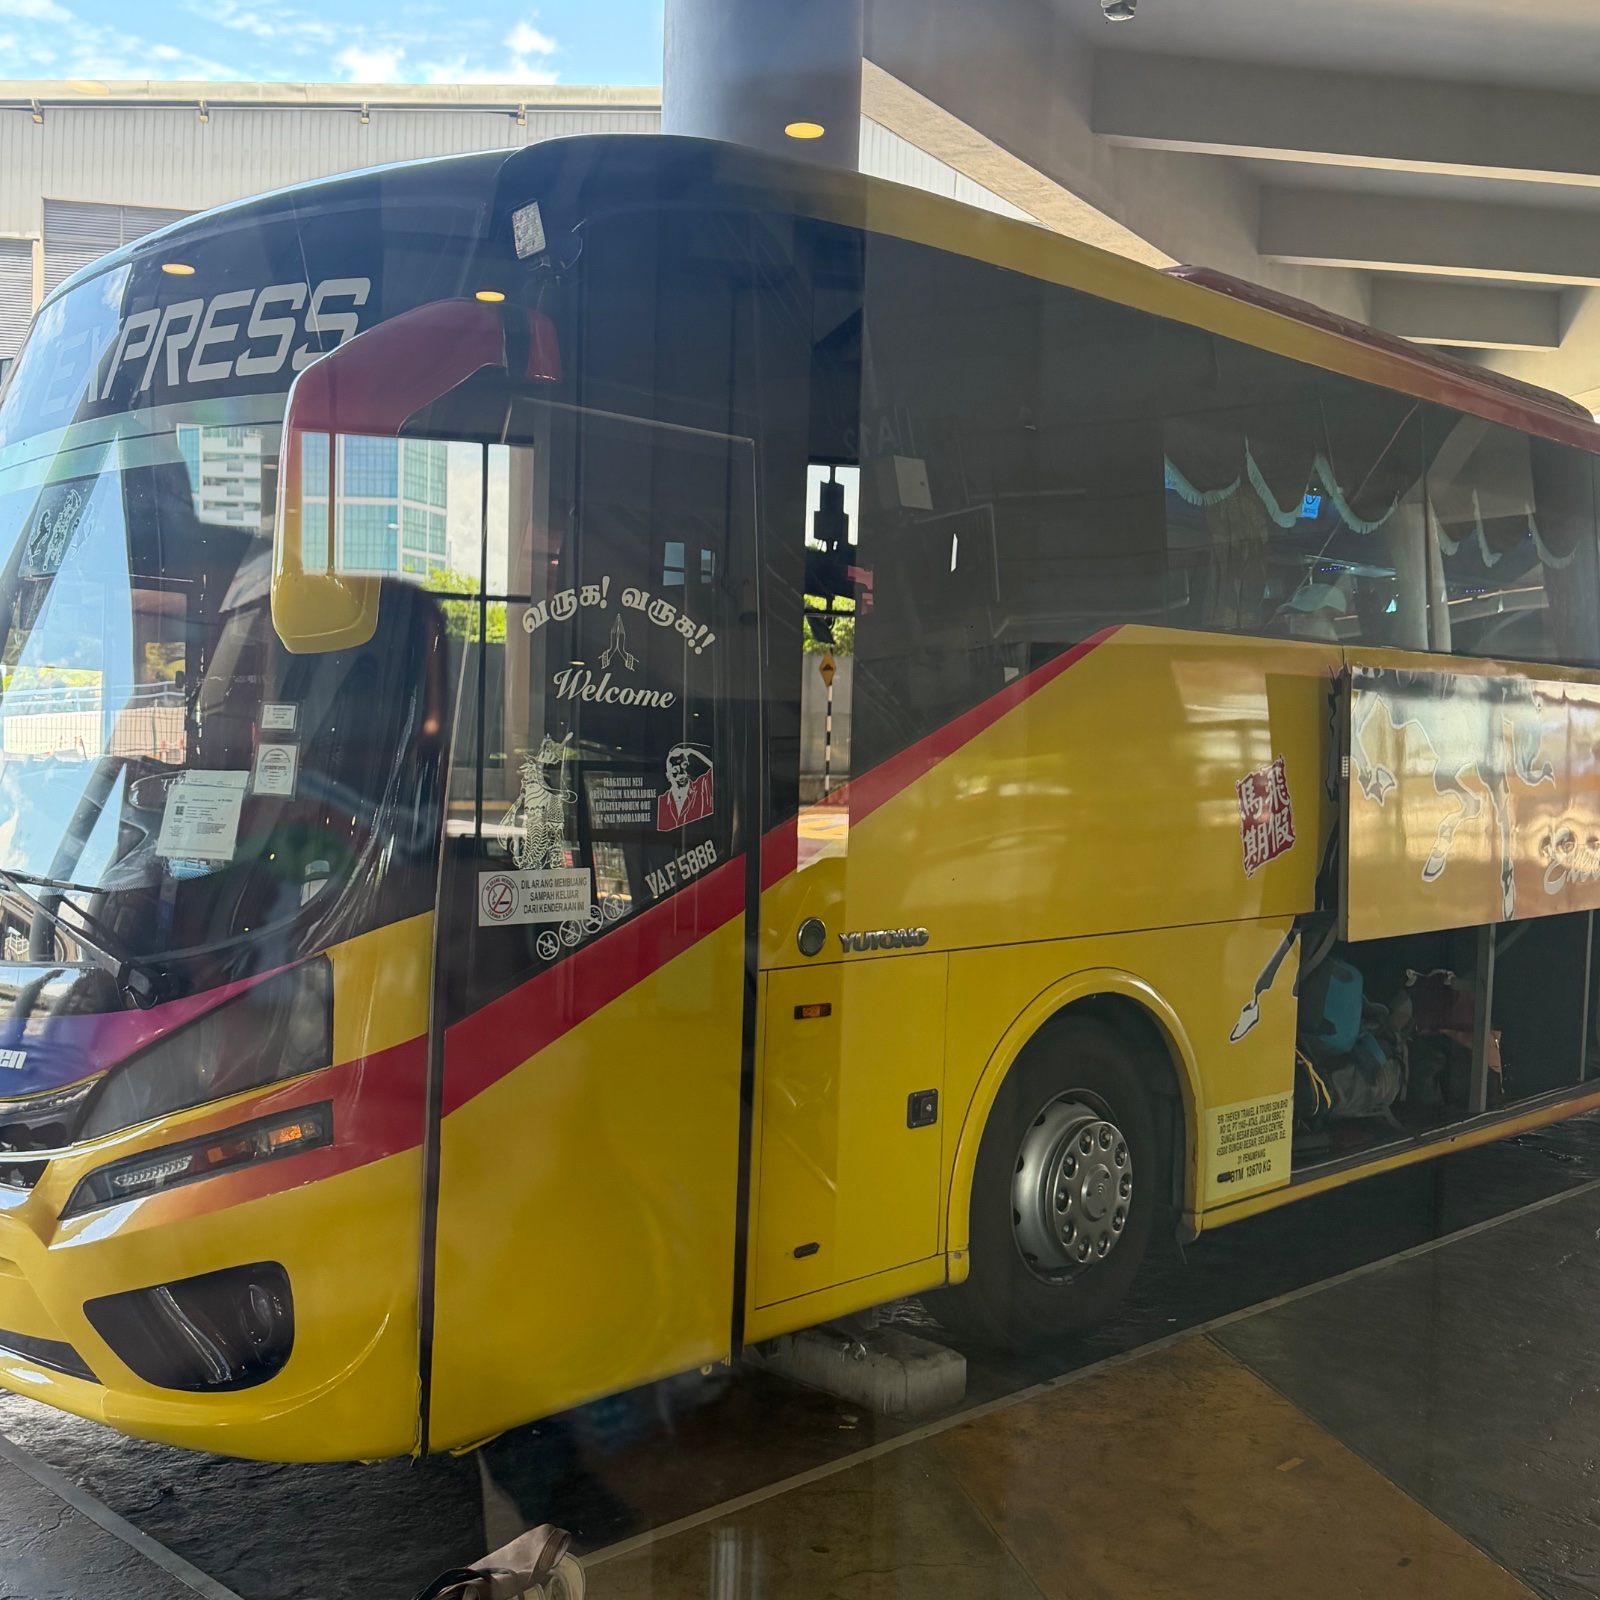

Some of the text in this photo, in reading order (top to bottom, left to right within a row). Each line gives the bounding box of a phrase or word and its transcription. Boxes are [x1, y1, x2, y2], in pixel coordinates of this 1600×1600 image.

[40, 277, 371, 416] EXPRESS
[522, 575, 610, 634] வருக!
[553, 668, 676, 708] Welcome
[645, 840, 718, 897] VAF 5888
[521, 877, 587, 890] DILARANG MEMBUANG
[530, 890, 580, 901] SAMPAH KELUAR
[524, 902, 585, 914] DARI KENDERAAN INI
[838, 927, 930, 953] YUTONG
[1241, 1107, 1255, 1119] TRAVEL
[1259, 1103, 1272, 1114] TOURS
[1272, 1101, 1280, 1111] SDN
[1280, 1099, 1288, 1109] BHD
[1221, 1121, 1283, 1145] SUNGAI BESAR BUSINESS CENTRE
[1229, 1142, 1243, 1153] SUNGAI
[1263, 1159, 1271, 1173] KG
